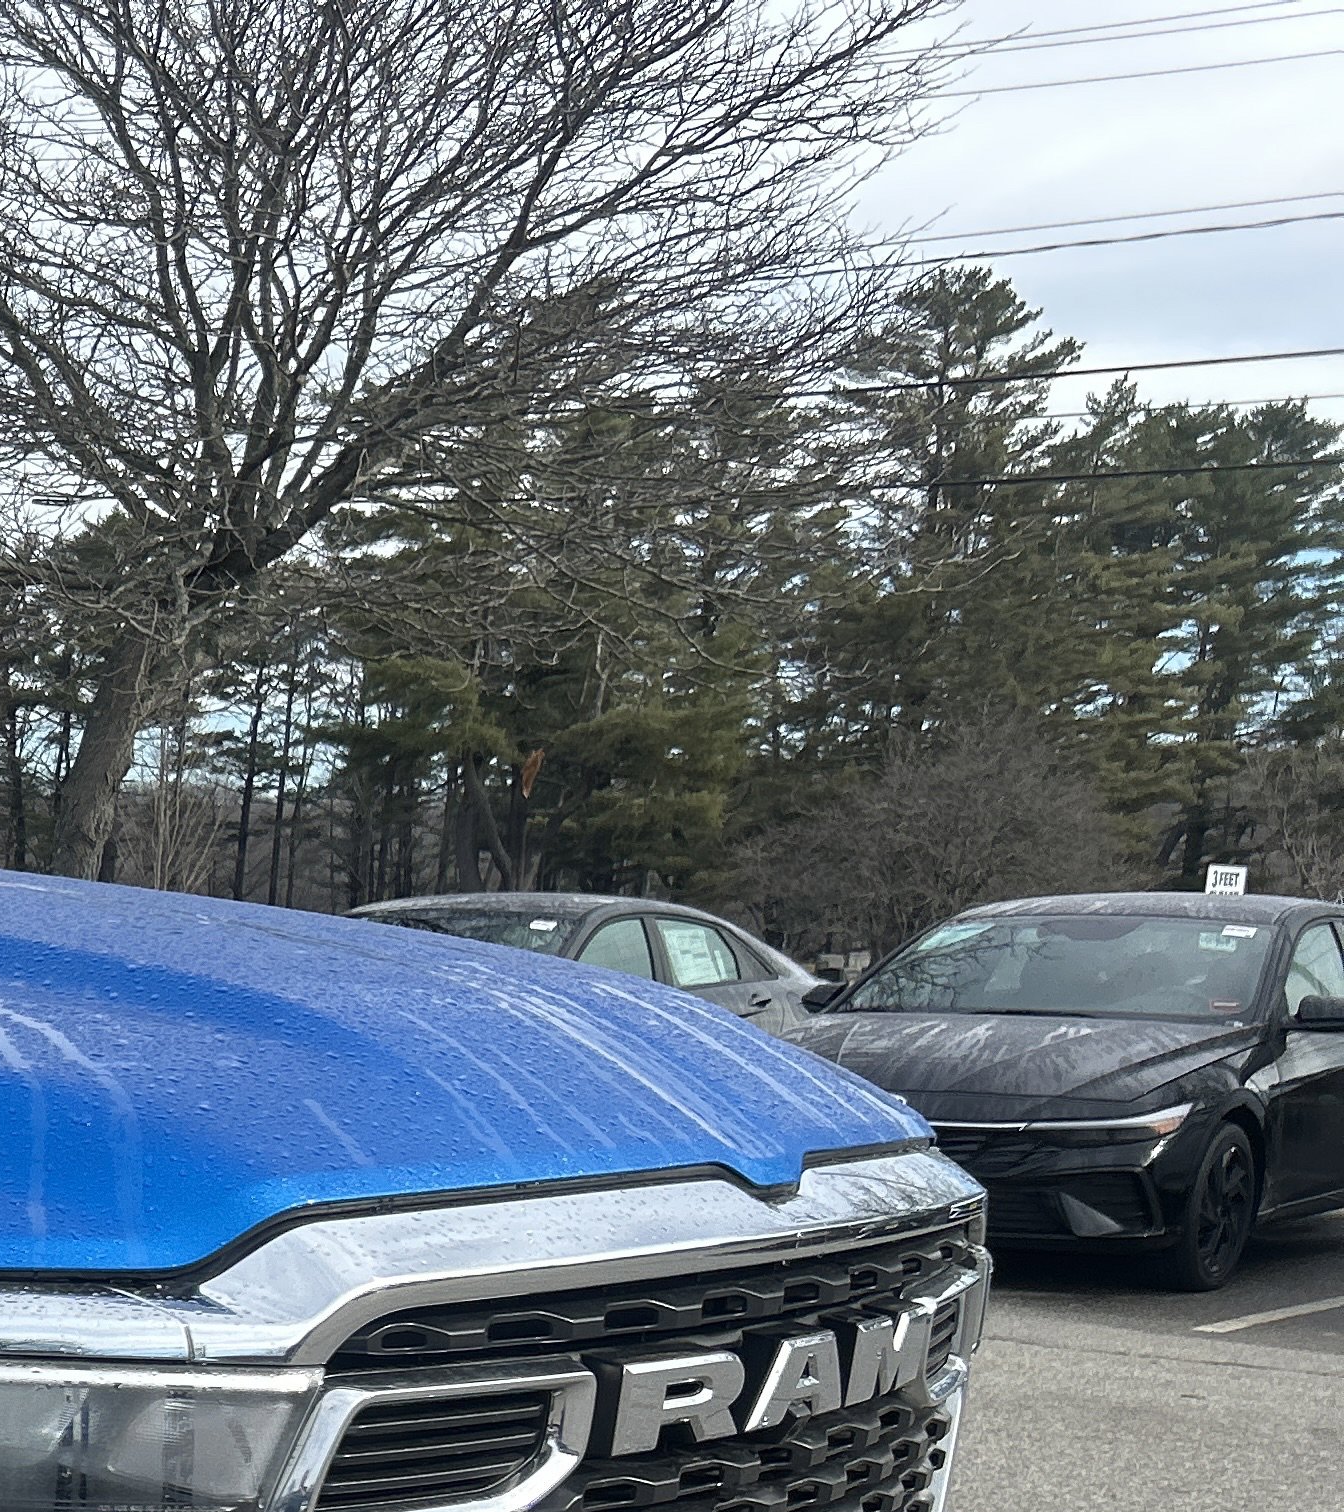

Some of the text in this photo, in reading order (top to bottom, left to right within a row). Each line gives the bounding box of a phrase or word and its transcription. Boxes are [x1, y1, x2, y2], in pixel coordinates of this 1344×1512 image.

[1212, 870, 1240, 887] 3 FEET
[611, 1303, 932, 1456] RAM
